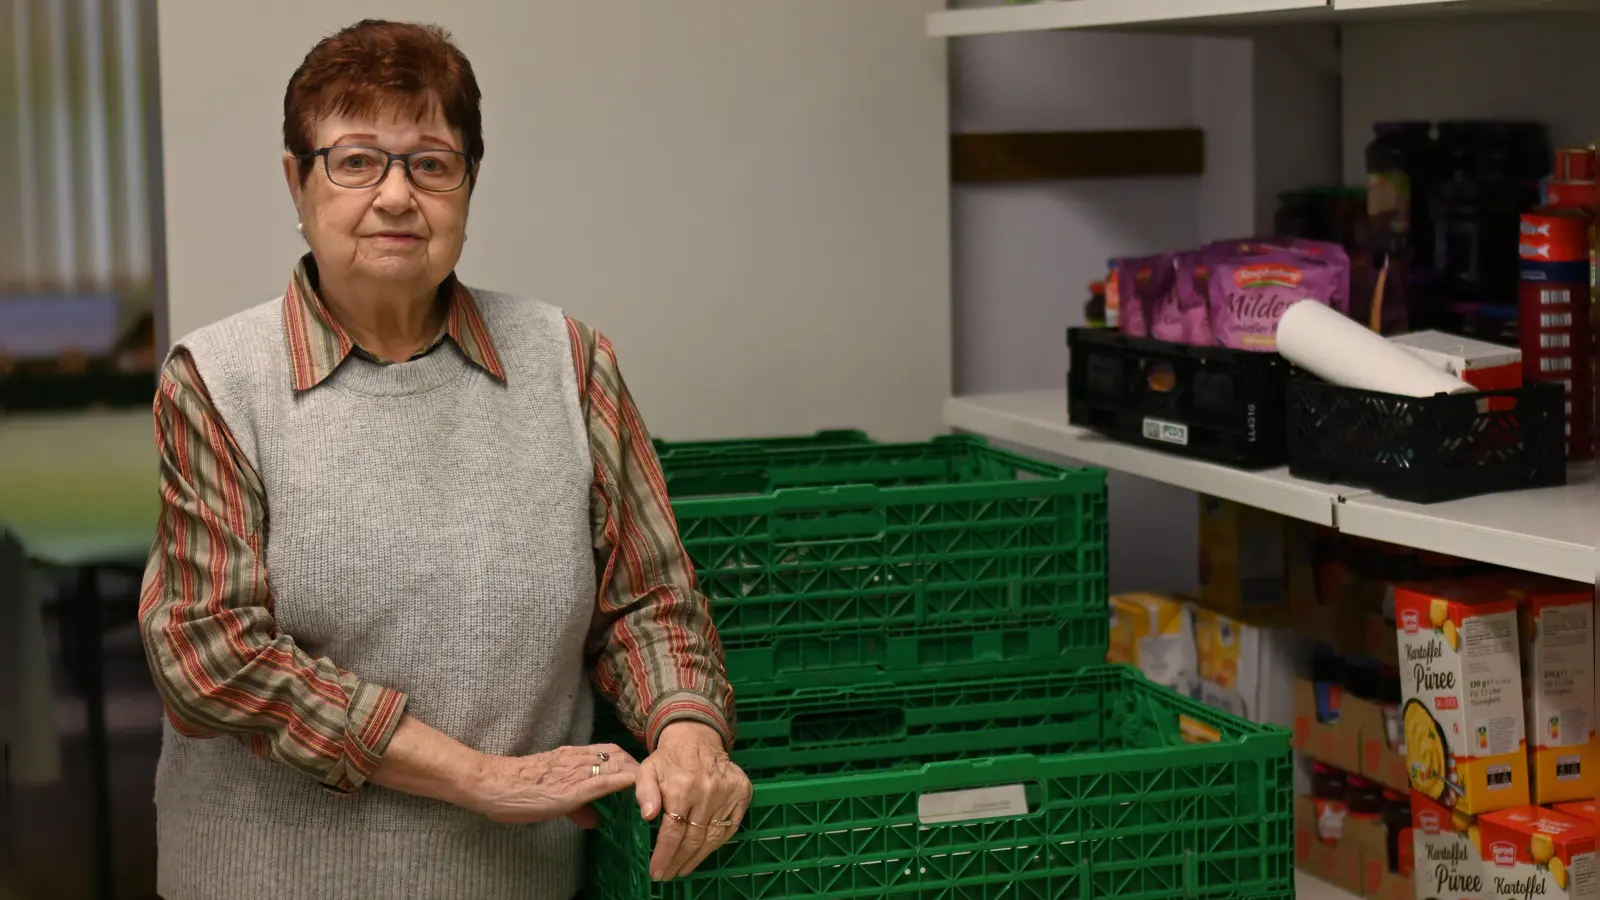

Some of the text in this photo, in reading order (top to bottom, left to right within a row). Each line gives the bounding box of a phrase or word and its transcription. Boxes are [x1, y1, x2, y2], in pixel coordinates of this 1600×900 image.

[1404, 639, 1443, 665] Kartoffel
[1413, 663, 1456, 693] Püree
[1424, 842, 1468, 866] Kartoffel
[1434, 863, 1483, 894] Püree
[1493, 874, 1546, 900] Kartoffel
